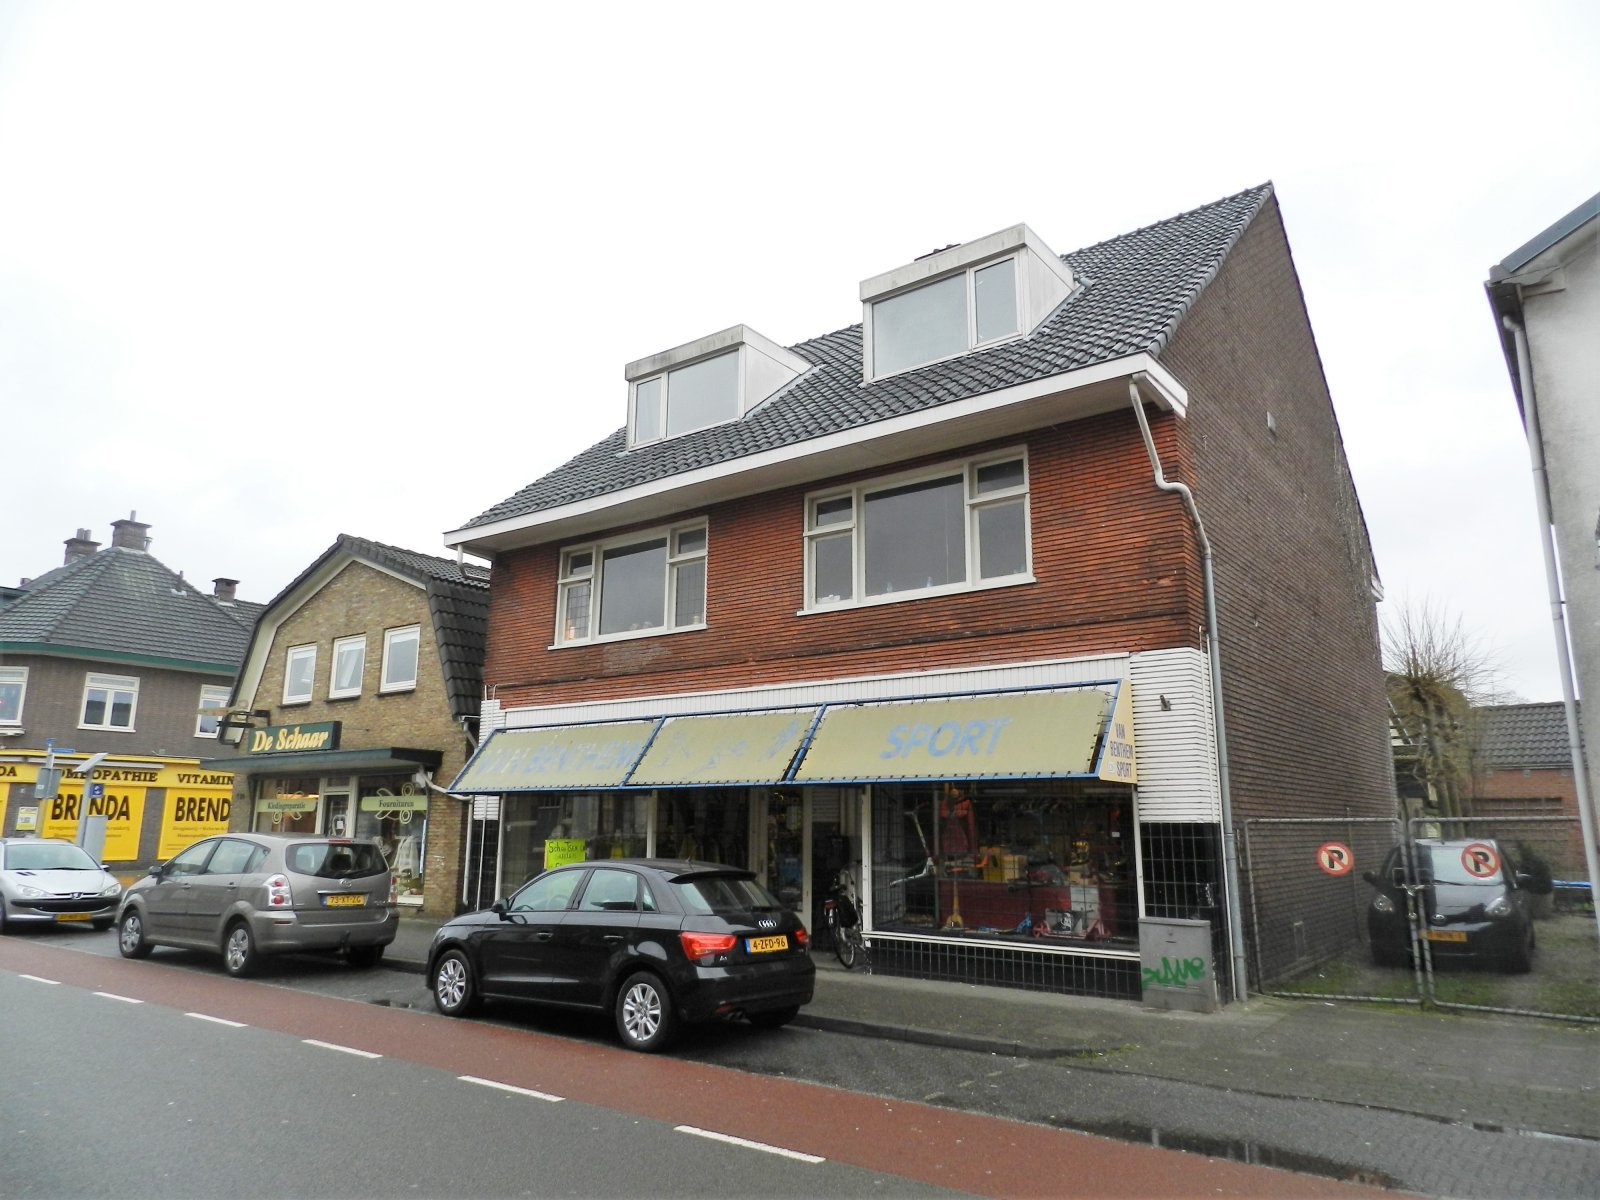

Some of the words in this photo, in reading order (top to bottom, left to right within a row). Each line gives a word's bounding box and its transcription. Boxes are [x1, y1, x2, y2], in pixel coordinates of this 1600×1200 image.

[251, 730, 273, 752] De
[275, 726, 329, 750] Schaar
[880, 717, 1012, 759] SPORT
[1115, 723, 1125, 739] VAN
[1116, 761, 1132, 778] SPORT
[752, 938, 786, 950] 4-ZFD-96
